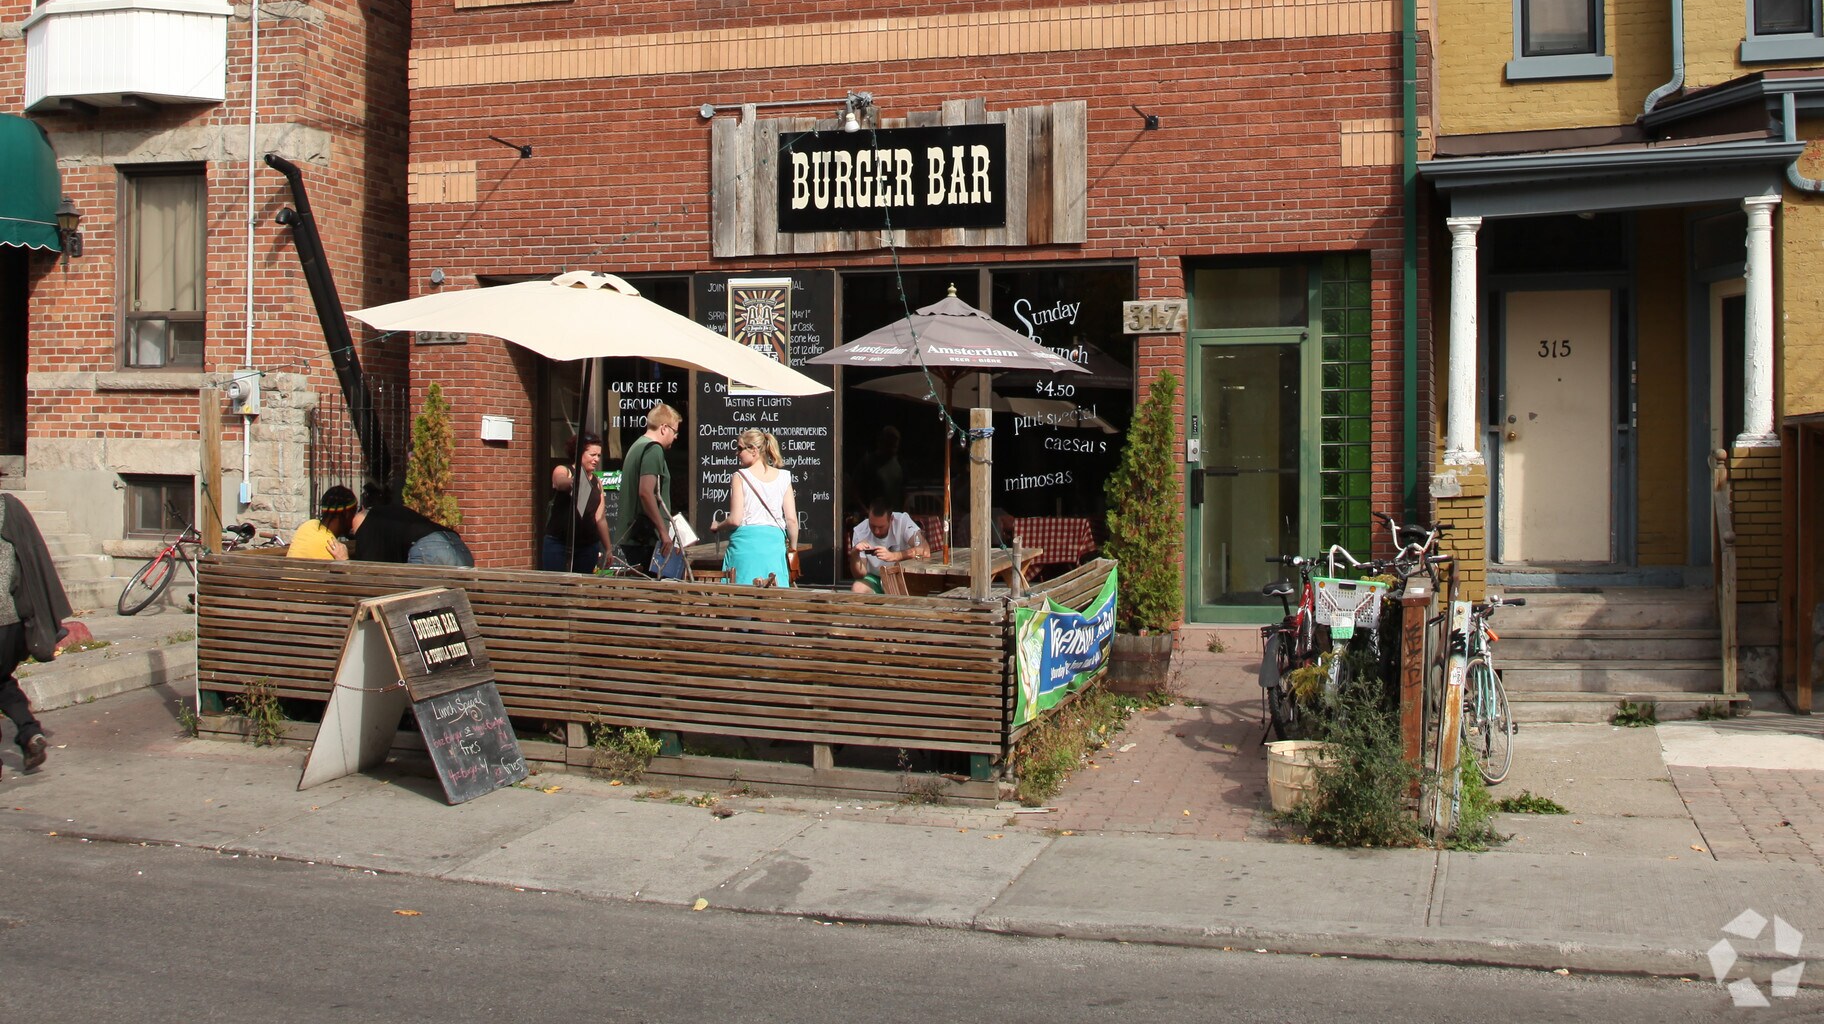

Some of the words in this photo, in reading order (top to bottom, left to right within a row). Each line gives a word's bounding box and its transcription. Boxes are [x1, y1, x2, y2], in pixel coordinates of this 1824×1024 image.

[791, 148, 915, 210] BURGER
[927, 145, 992, 206] BAR
[1014, 298, 1081, 339] Sunday
[1129, 304, 1182, 331] 317
[927, 344, 1019, 357] Amsterdam
[1538, 340, 1571, 358] 315
[611, 381, 634, 394] OUR
[637, 381, 663, 394] BEEF
[667, 381, 678, 394] IS
[703, 382, 711, 393] 8
[1036, 379, 1076, 397] $4.50
[612, 415, 626, 428] IN
[788, 440, 816, 451] EUROPE
[797, 455, 821, 466] Bottles
[1004, 470, 1073, 491] mimosas
[701, 487, 729, 503] Happy
[812, 491, 830, 503] pints
[413, 615, 445, 640] BURGER
[440, 612, 460, 634] BAR
[431, 701, 458, 720] Lunch
